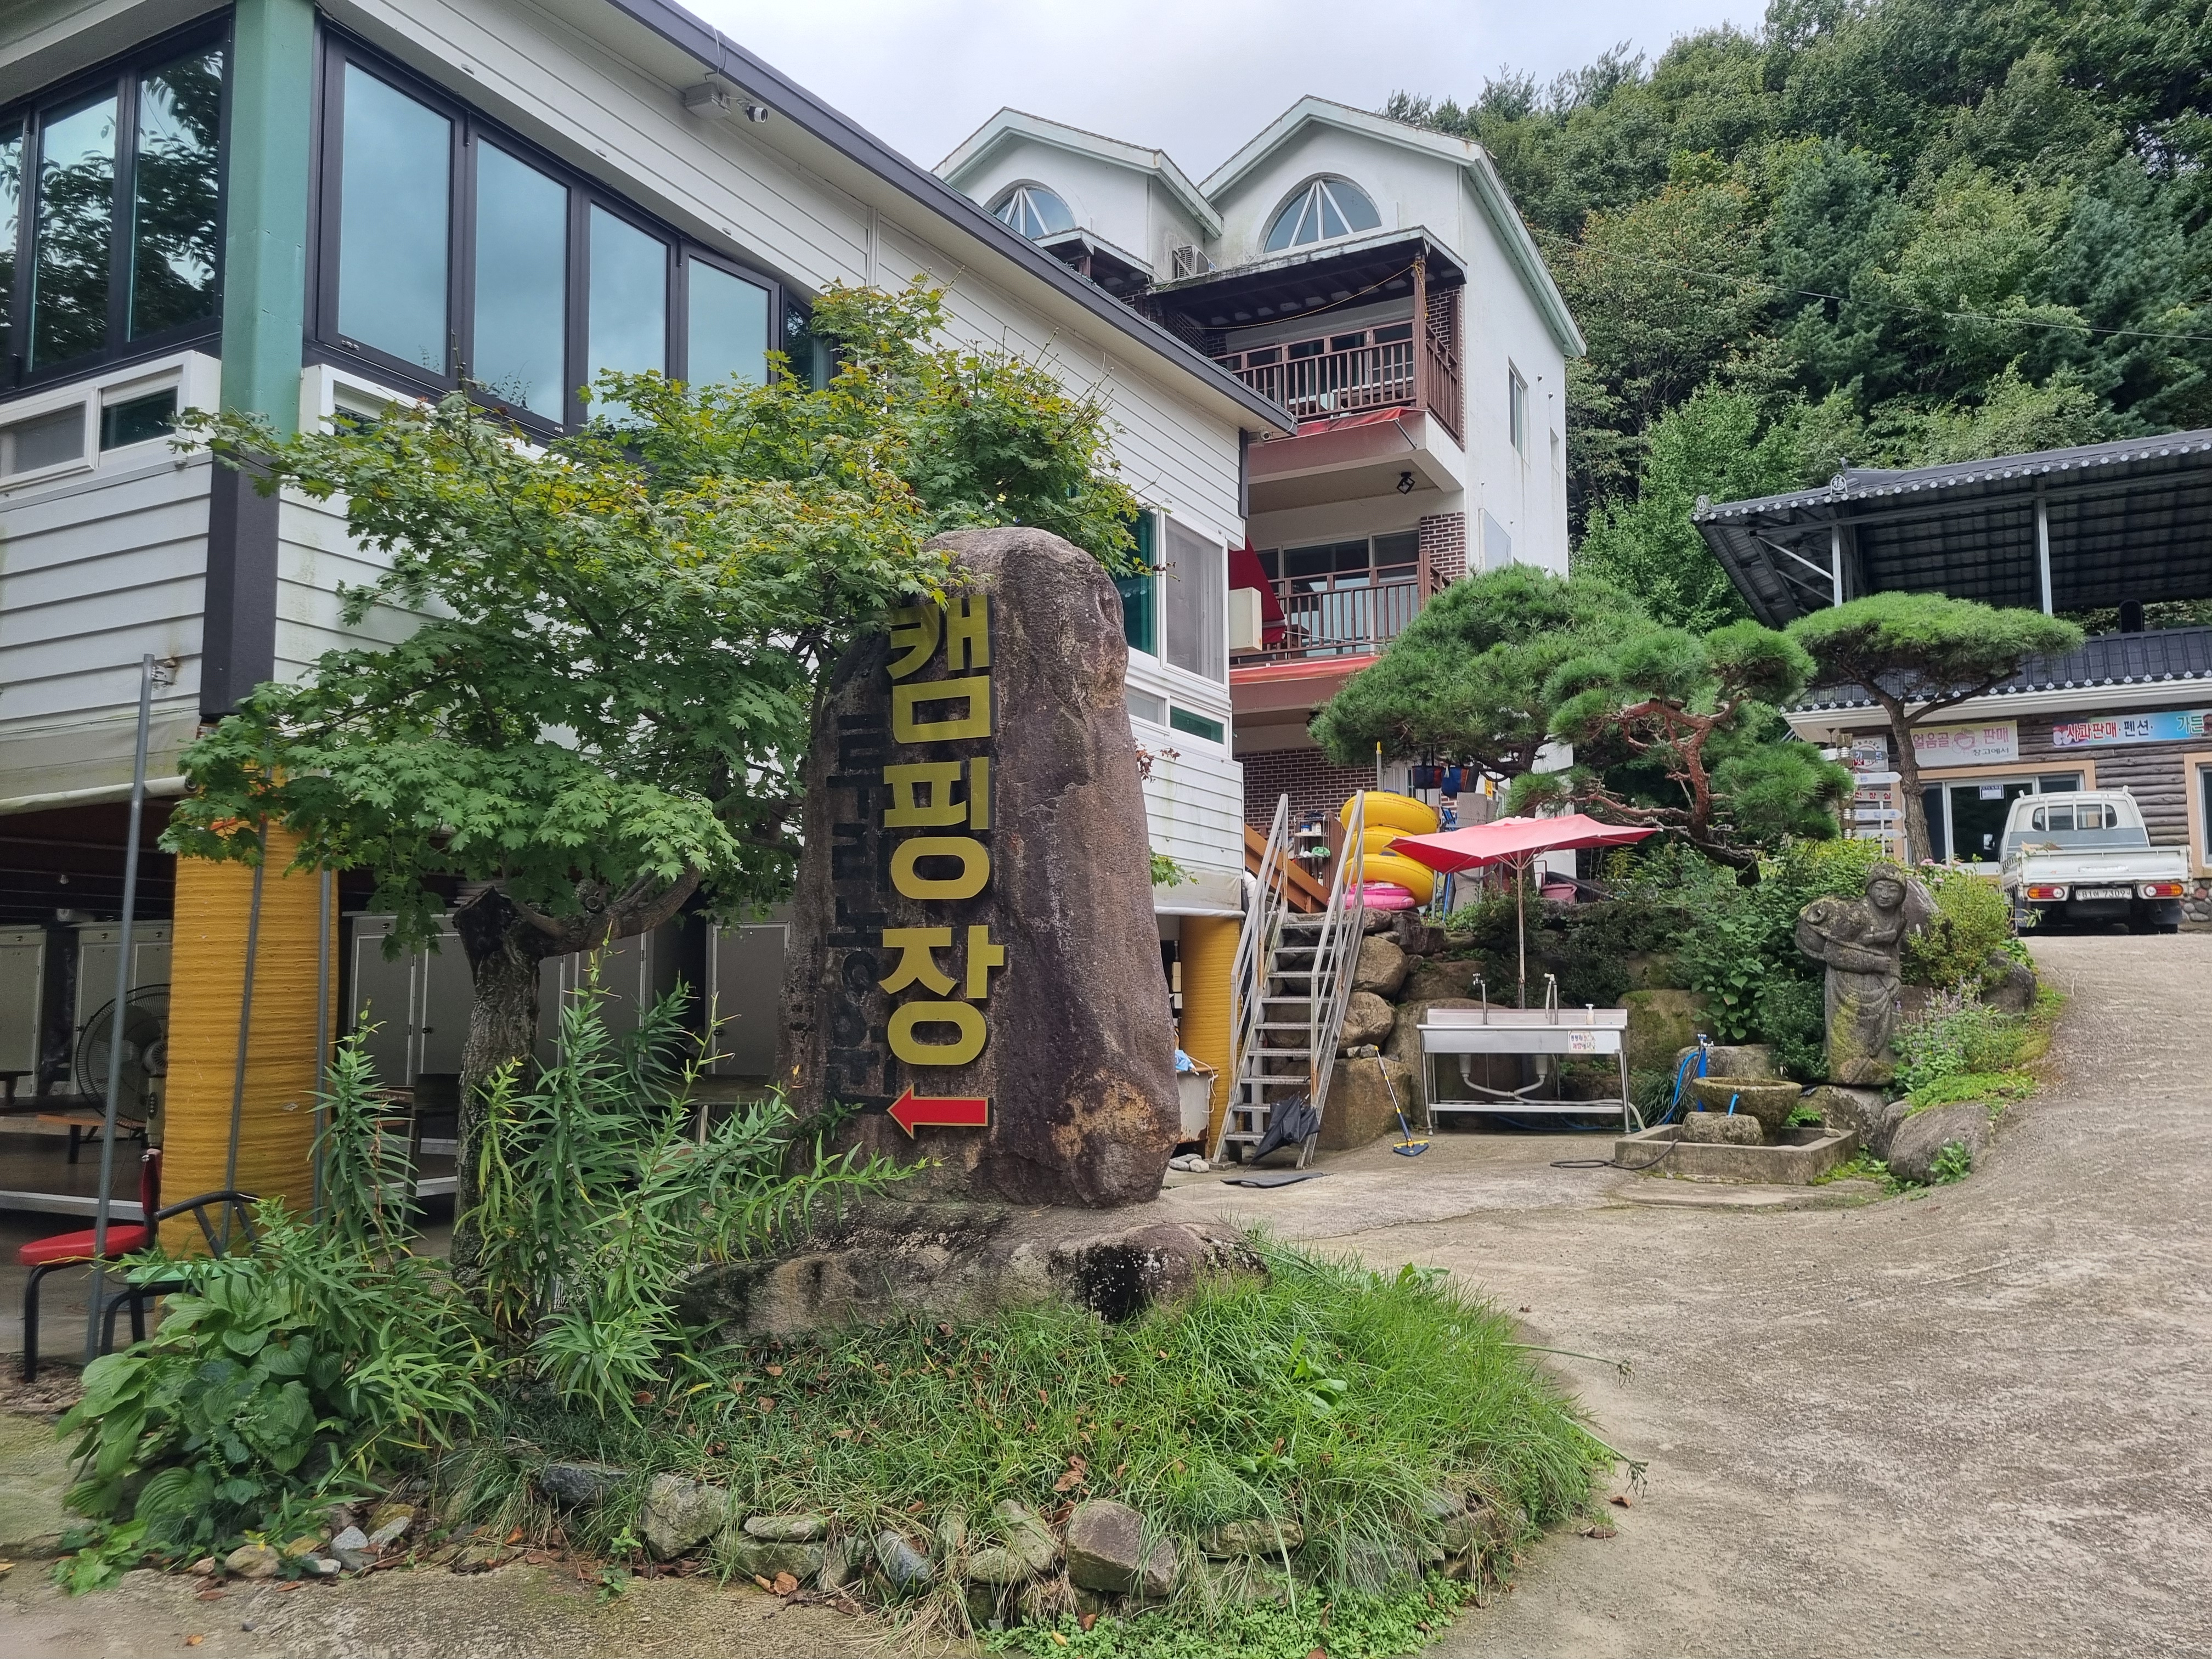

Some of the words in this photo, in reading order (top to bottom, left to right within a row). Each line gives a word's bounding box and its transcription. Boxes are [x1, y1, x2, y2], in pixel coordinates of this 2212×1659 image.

[2177, 715, 2204, 735] 가든
[1912, 732, 1949, 749] 얼음골
[1983, 727, 2009, 744] 판매
[879, 594, 1005, 1065] 캠핑장
